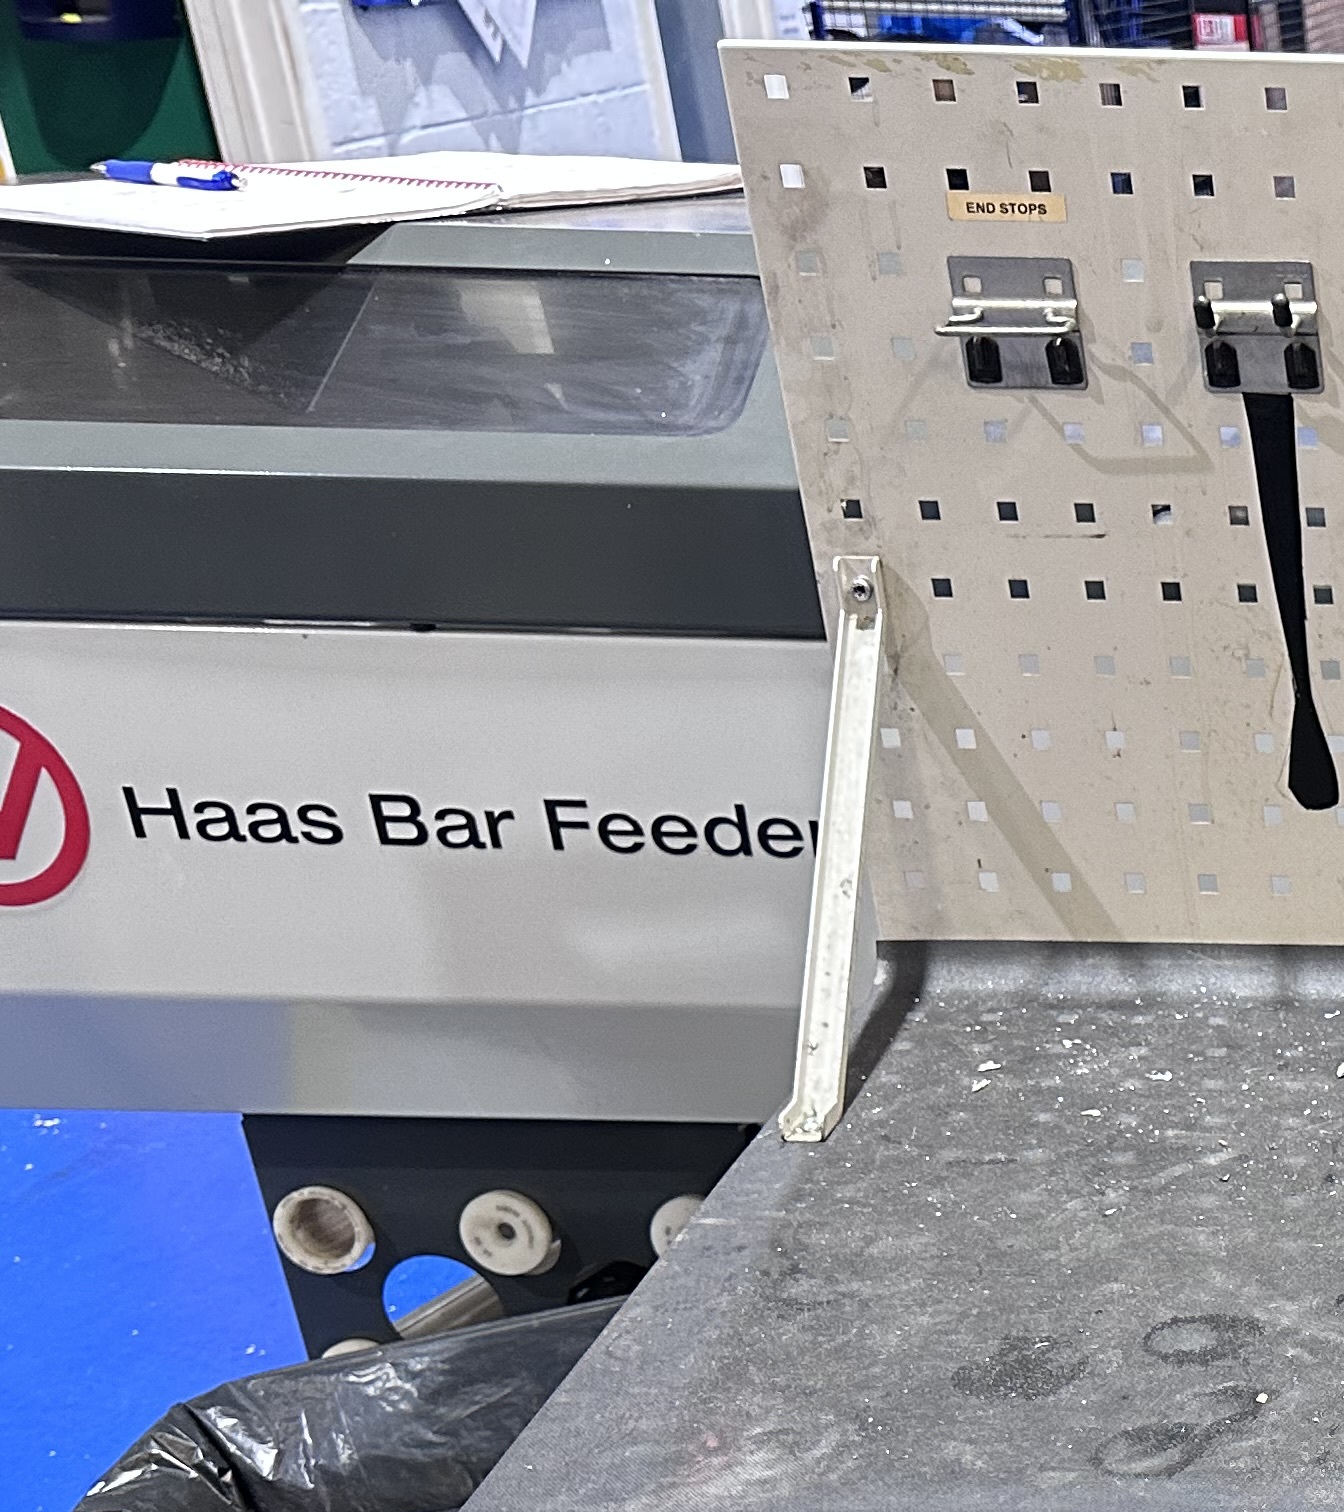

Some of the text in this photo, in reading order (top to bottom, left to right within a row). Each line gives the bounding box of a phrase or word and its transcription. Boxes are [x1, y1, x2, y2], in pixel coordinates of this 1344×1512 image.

[966, 202, 1047, 215] END STOPS
[122, 785, 343, 848] Haas
[369, 792, 515, 851] Bar
